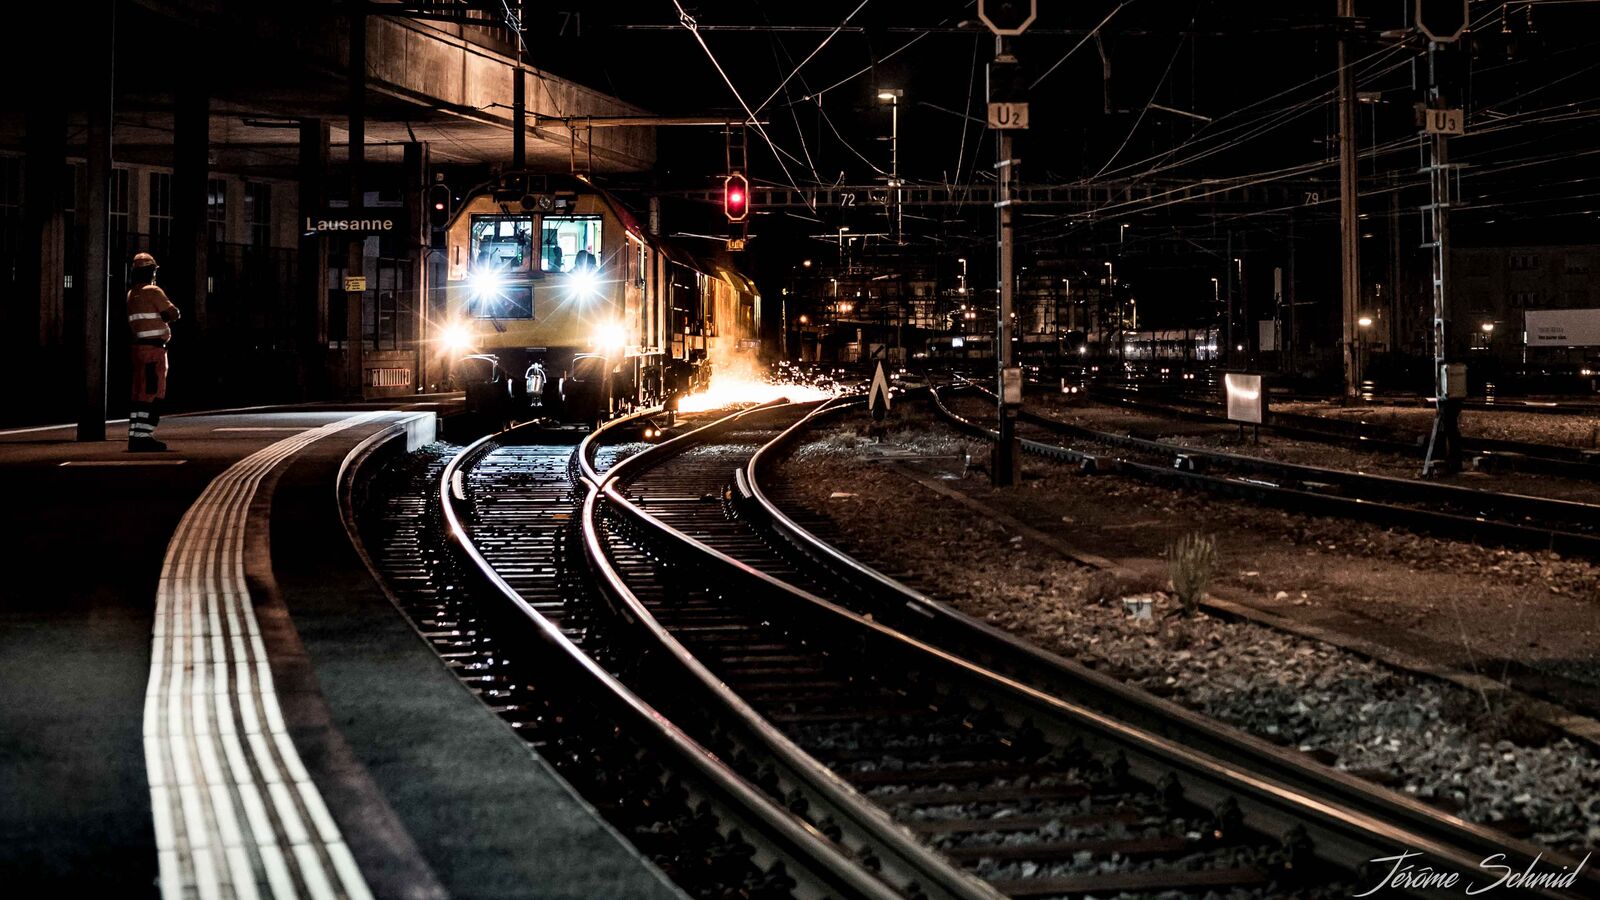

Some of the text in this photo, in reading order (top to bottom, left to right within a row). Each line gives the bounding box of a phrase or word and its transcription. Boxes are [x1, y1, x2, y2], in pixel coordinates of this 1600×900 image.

[558, 11, 581, 37] 71
[997, 106, 1020, 126] U2
[840, 193, 856, 207] 72
[1304, 191, 1319, 206] 79
[306, 216, 393, 231] Lausanne
